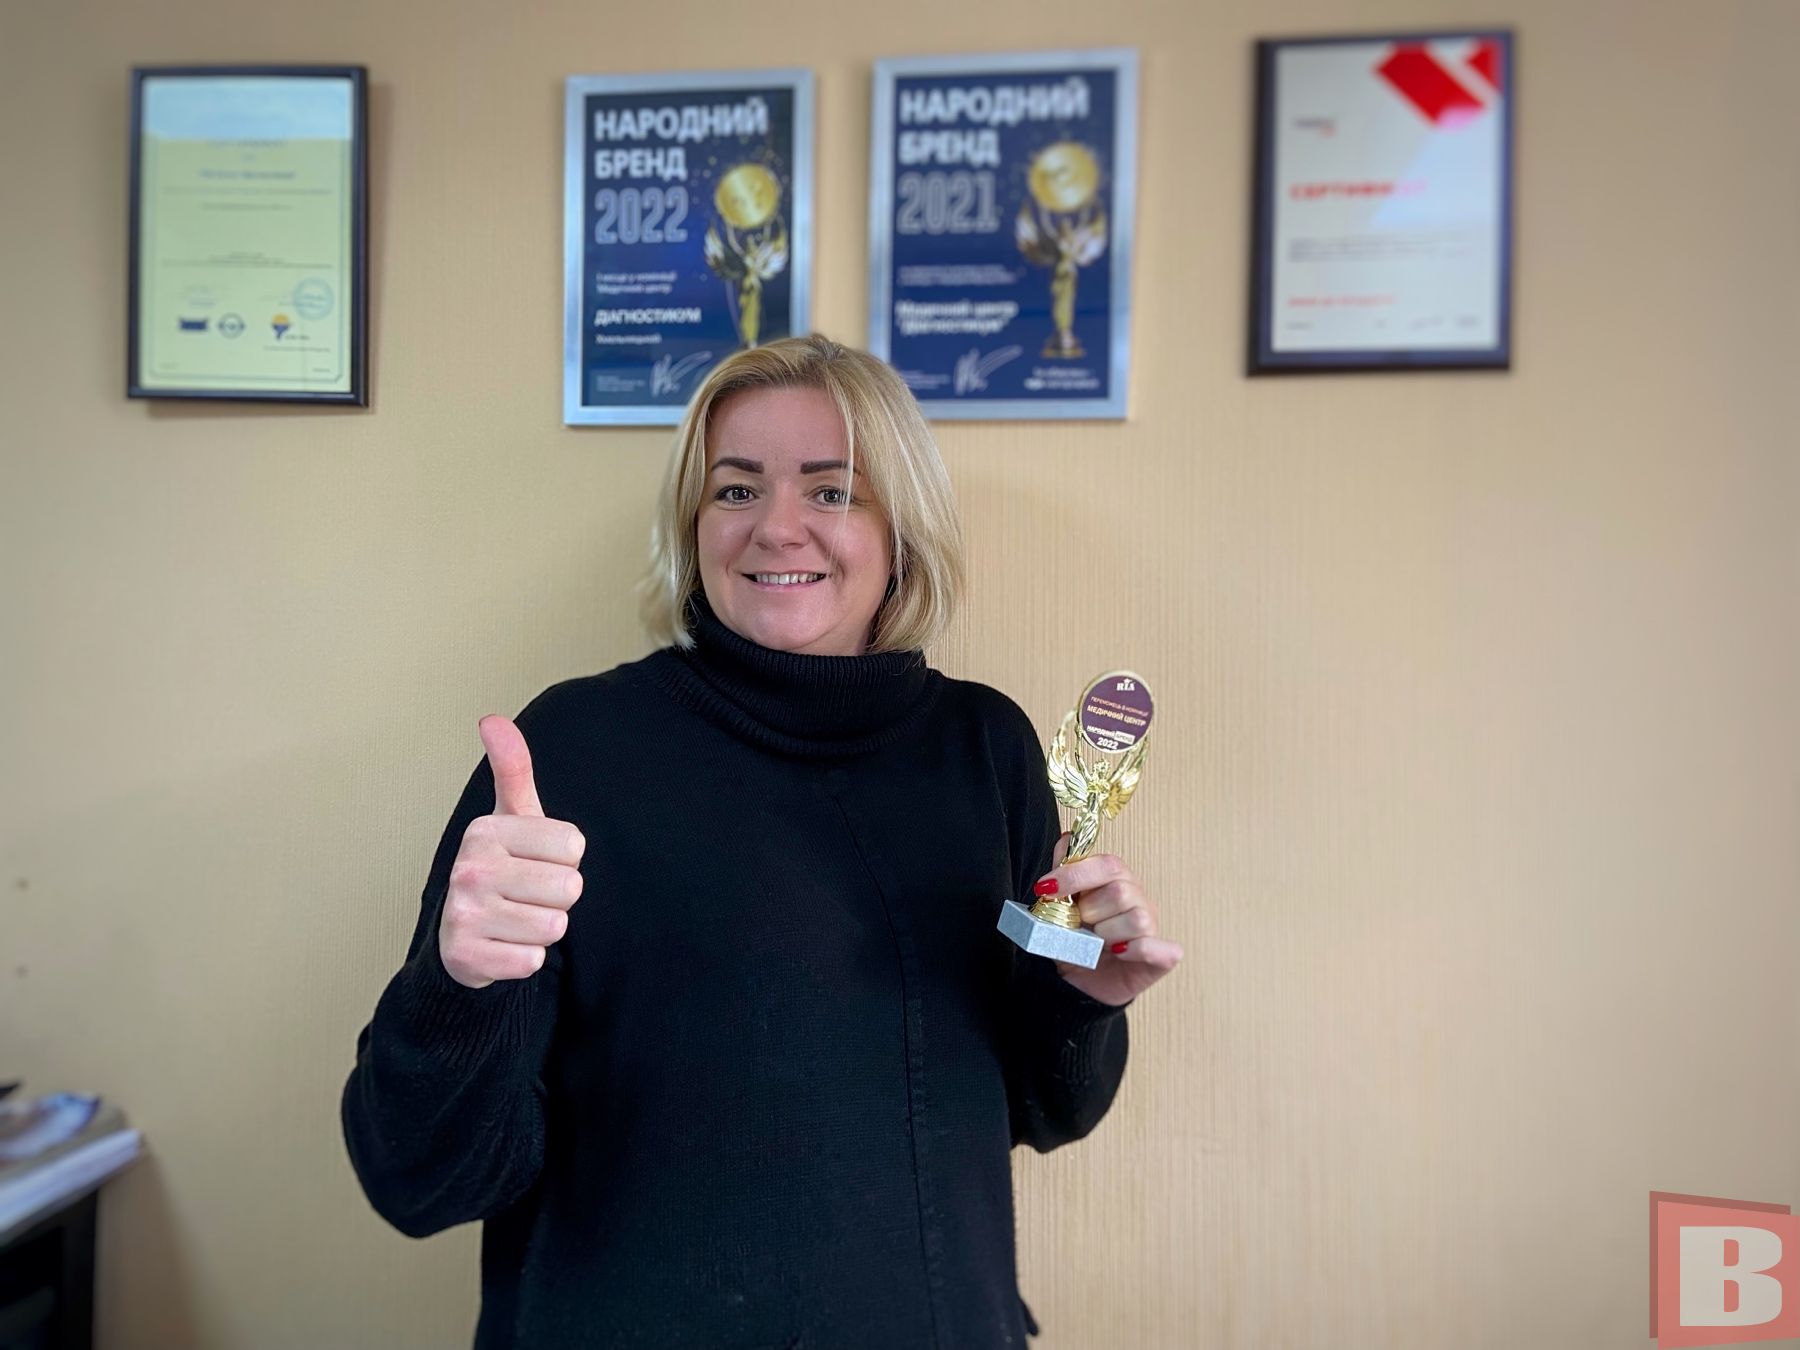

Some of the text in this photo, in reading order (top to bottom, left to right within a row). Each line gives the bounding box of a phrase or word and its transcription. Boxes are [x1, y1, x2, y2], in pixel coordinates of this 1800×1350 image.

[899, 76, 1090, 126] НАРОДНИЙ
[595, 100, 768, 142] НАРОДНИЙ
[595, 147, 687, 182] БРЕНД
[899, 130, 1000, 167] БРЕНД
[595, 187, 689, 245] 2022
[897, 173, 999, 235] 2021
[595, 307, 702, 327] ДІАГНОСТИКУМ
[1087, 705, 1147, 727] МЕДИЧНИЙ ЦЕНТР
[1096, 737, 1119, 750] 2022
